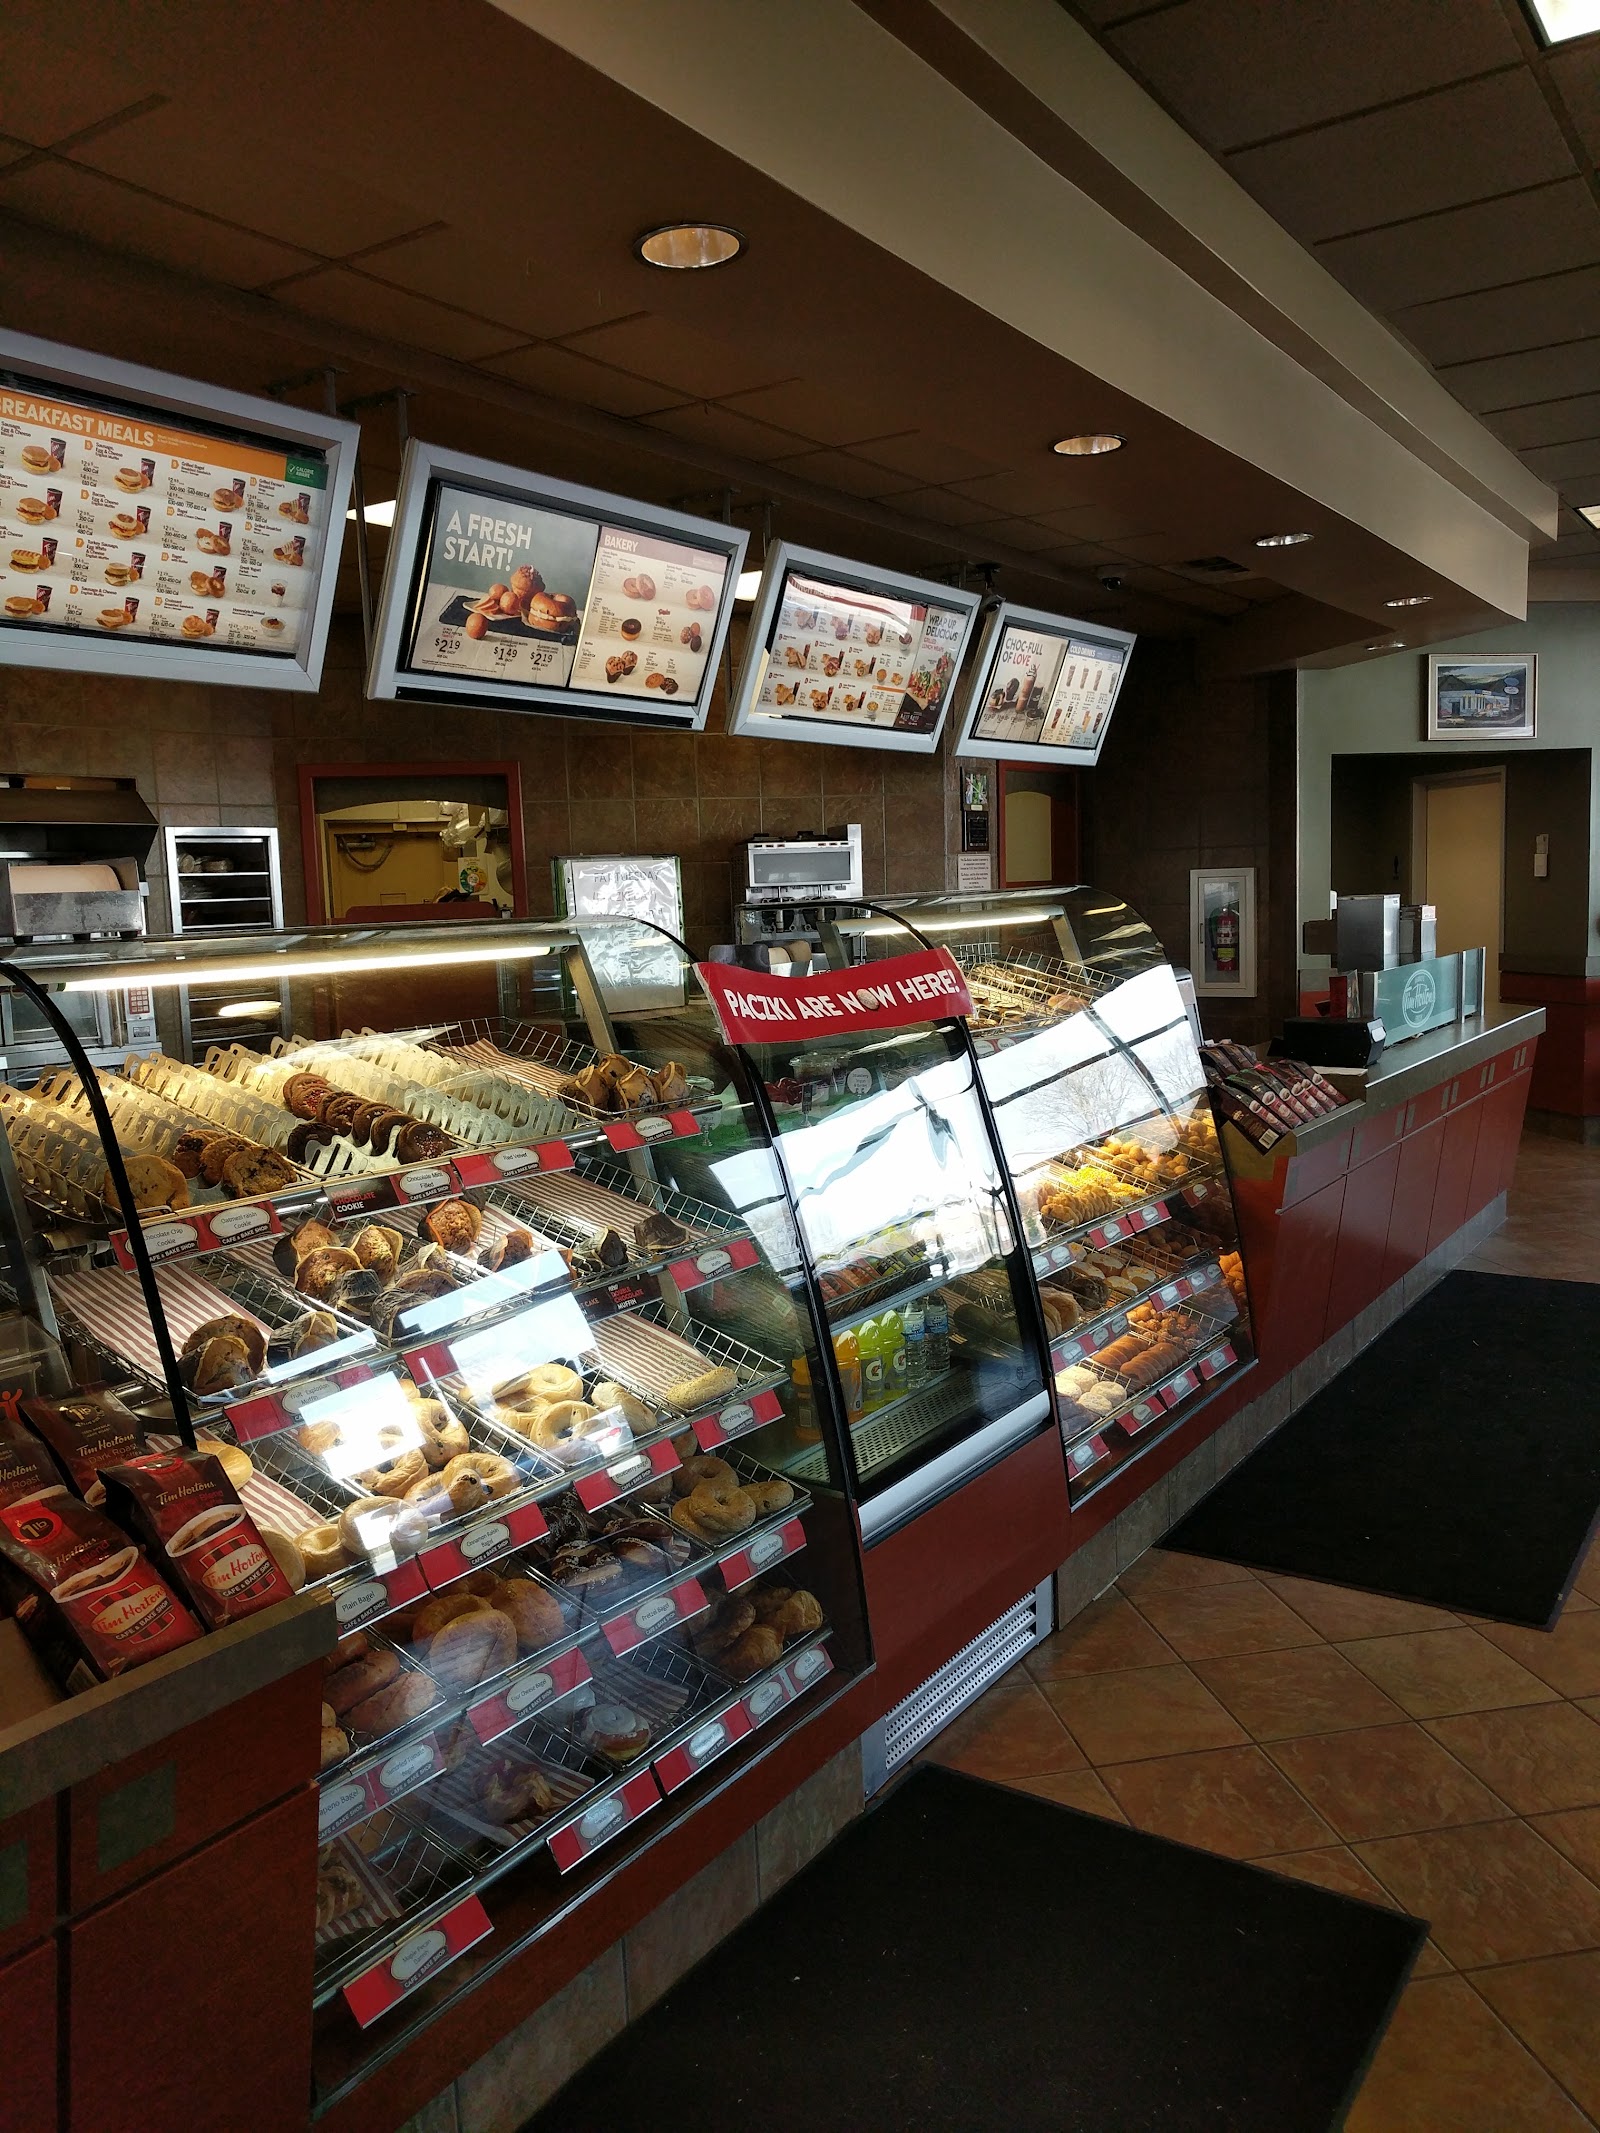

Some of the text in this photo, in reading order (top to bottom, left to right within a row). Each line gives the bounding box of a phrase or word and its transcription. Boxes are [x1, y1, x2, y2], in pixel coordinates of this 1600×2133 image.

[0, 398, 94, 432] REAKFAST
[98, 420, 154, 447] MEALS
[15, 429, 31, 437] Cheese
[12, 480, 28, 488] Cheese
[104, 498, 119, 506] Cheese
[446, 510, 532, 550] A FRESH
[604, 535, 639, 552] BAKERY
[444, 536, 513, 572] START!
[929, 615, 956, 629] WRAP UP
[926, 626, 958, 641] DELICIOUS
[1005, 637, 1043, 656] CHOC-FULL
[1070, 644, 1096, 658] COLD DRINKS
[1002, 651, 1031, 667] OF LOVE
[615, 871, 659, 882] TUESDAY
[723, 988, 797, 1021] PACZKI
[795, 996, 843, 1020] ARE
[896, 968, 960, 1004] HERE!
[514, 1152, 527, 1160] Velvet
[407, 1174, 432, 1182] Chocolate
[331, 1188, 360, 1199] DOUBLE
[334, 1192, 376, 1205] CHOCOLATE
[410, 1193, 423, 1201] CAFE
[426, 1189, 438, 1197] BAKE
[337, 1201, 365, 1213] COOKIE
[221, 1215, 243, 1224] Oatmeal
[233, 1221, 251, 1230] Cookie
[144, 1228, 183, 1241] hocolate Chip
[222, 1225, 268, 1245] CAFE BAKE SHOP
[156, 1238, 176, 1247] Cookie
[149, 1243, 195, 1262] AFE BAKE SHOP
[611, 1287, 631, 1298] DOUBLE
[614, 1288, 644, 1303] CHOCOLATE
[585, 1298, 599, 1307] CAKE
[617, 1299, 637, 1310] MUFFIN
[306, 1383, 329, 1395] Explosion
[721, 1411, 740, 1424] Everything
[76, 1444, 98, 1457] Tim
[88, 1443, 139, 1464] Dark Roast
[12, 1475, 40, 1488] Roast
[156, 1491, 178, 1505] Tim
[466, 1528, 499, 1547] Cinnamon Raisin
[481, 1539, 494, 1547] Bagel
[471, 1540, 508, 1565] CAFE BAKE SHOP
[203, 1571, 231, 1587] Tim
[223, 1561, 271, 1597] CAFE BAKE SHOP
[342, 1592, 375, 1612] Plain Bagel
[344, 1600, 386, 1630] CAFE BAKE SHOP
[642, 1602, 670, 1621] Pretzel Bagel
[94, 1617, 122, 1633] Tim
[115, 1600, 169, 1641] CAFE BAKE SHOP
[521, 1686, 535, 1698] Cheese
[535, 1678, 547, 1691] Bagel
[518, 1689, 553, 1718] CAFE BAKE SHOP
[391, 1763, 432, 1796] CAFE BAKE SHOP
[340, 1789, 359, 1806] Bagel
[318, 1803, 363, 1840] CAFE BAKE SHOP
[403, 1940, 432, 1962] Maple Pecan
[404, 1948, 446, 1988] CAFE BAKE SHOP
